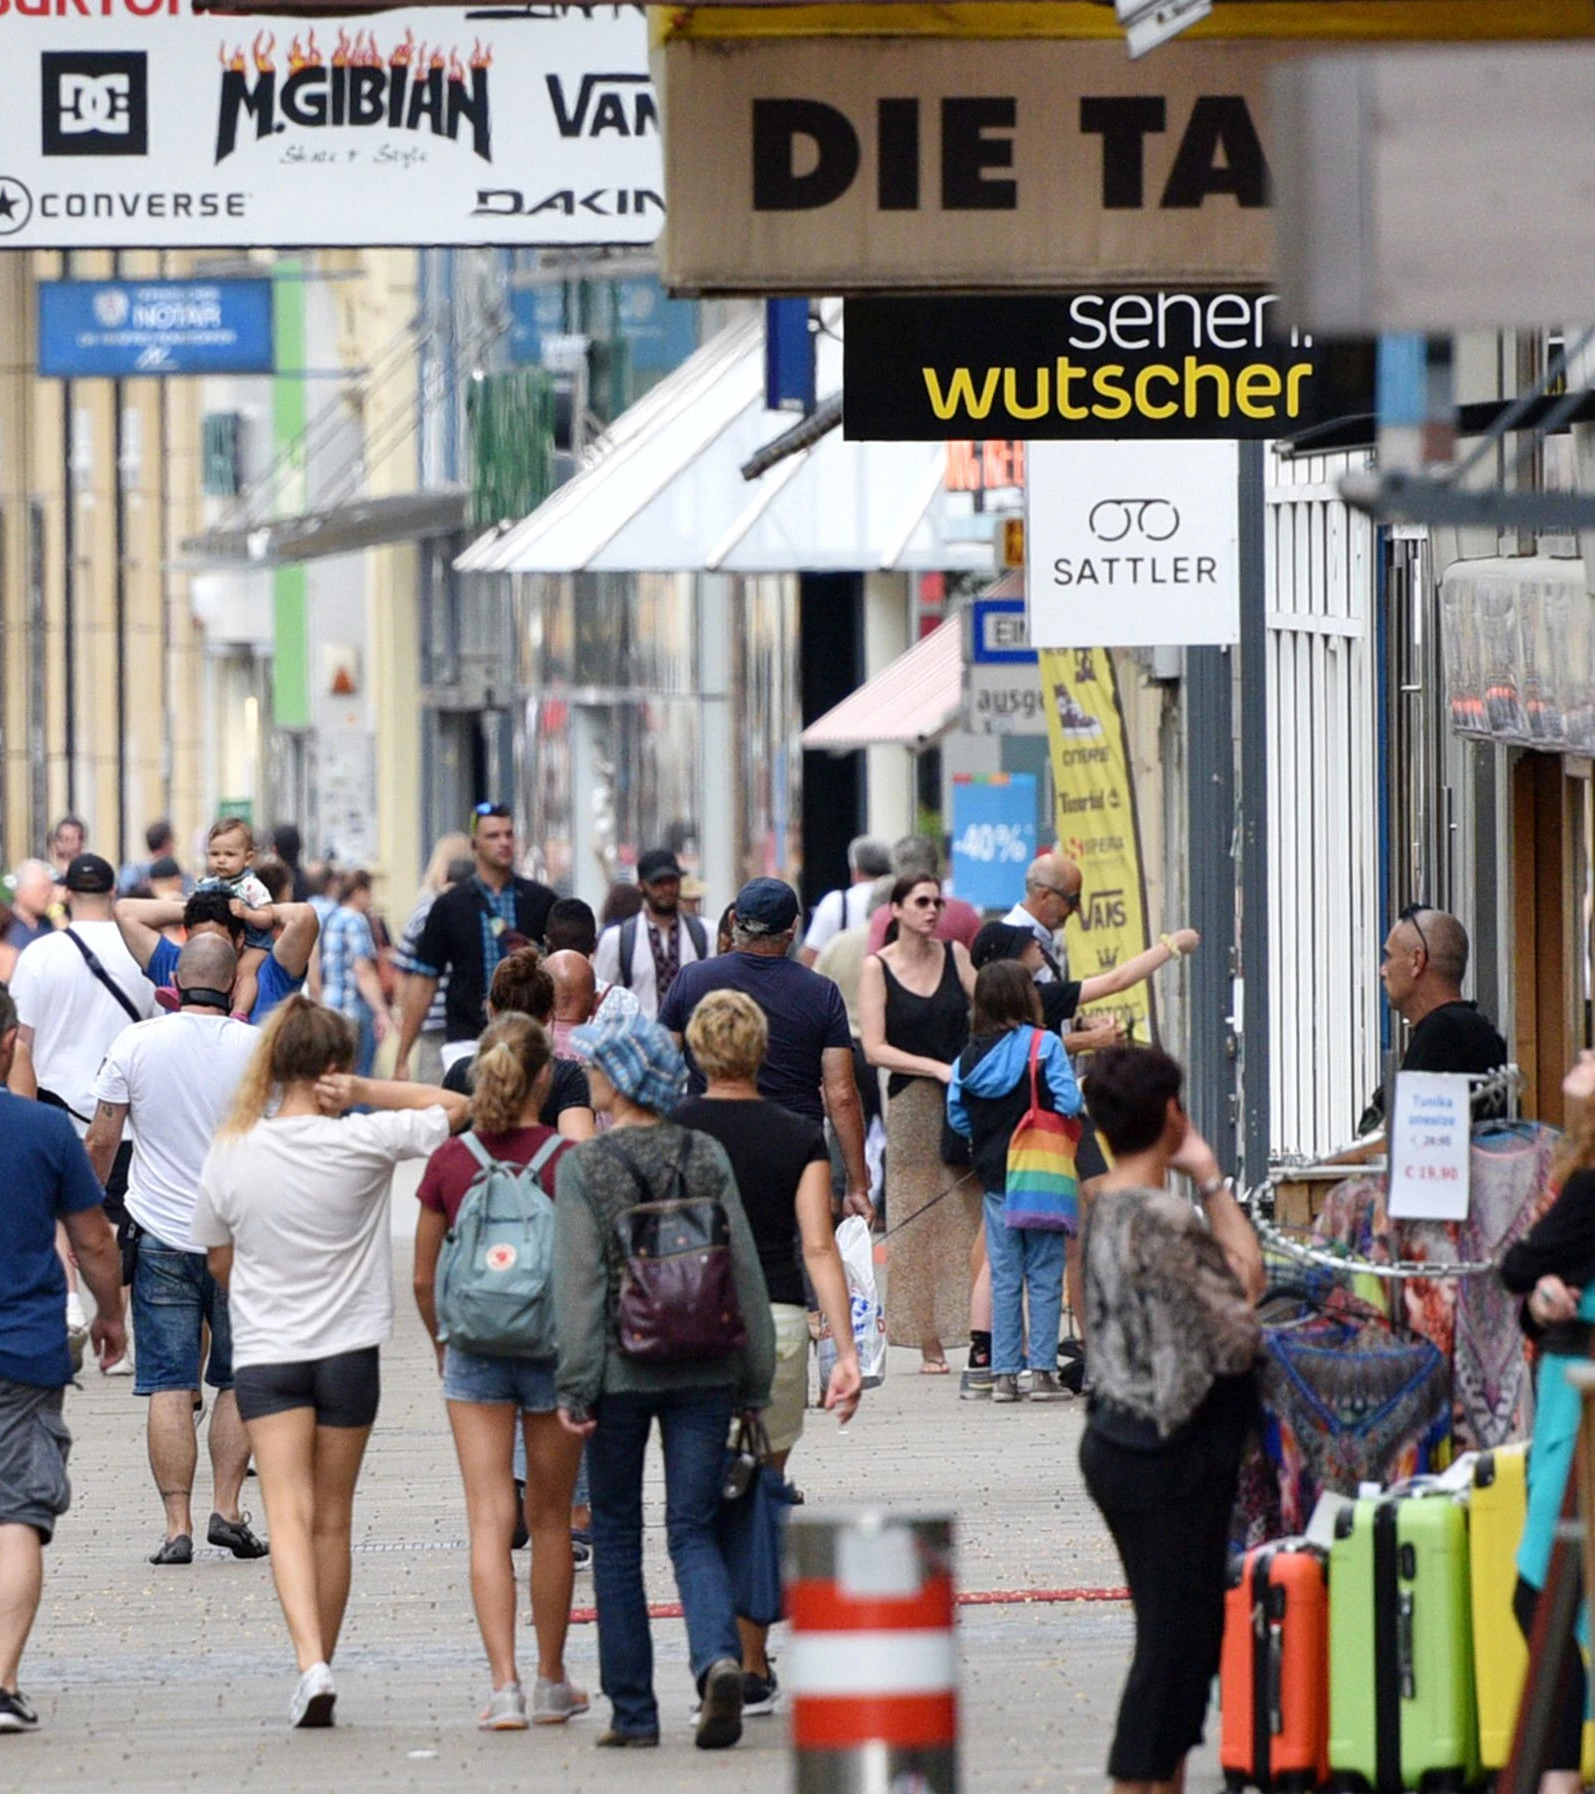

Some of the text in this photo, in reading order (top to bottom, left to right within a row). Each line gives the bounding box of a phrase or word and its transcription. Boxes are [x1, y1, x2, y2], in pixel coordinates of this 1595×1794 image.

[544, 73, 659, 138] VAN
[751, 97, 1017, 211] DIE
[40, 193, 246, 217] CONVERSE
[470, 188, 666, 216] DAKIN
[922, 356, 1313, 420] wutscher
[1053, 557, 1218, 586] SATTLER
